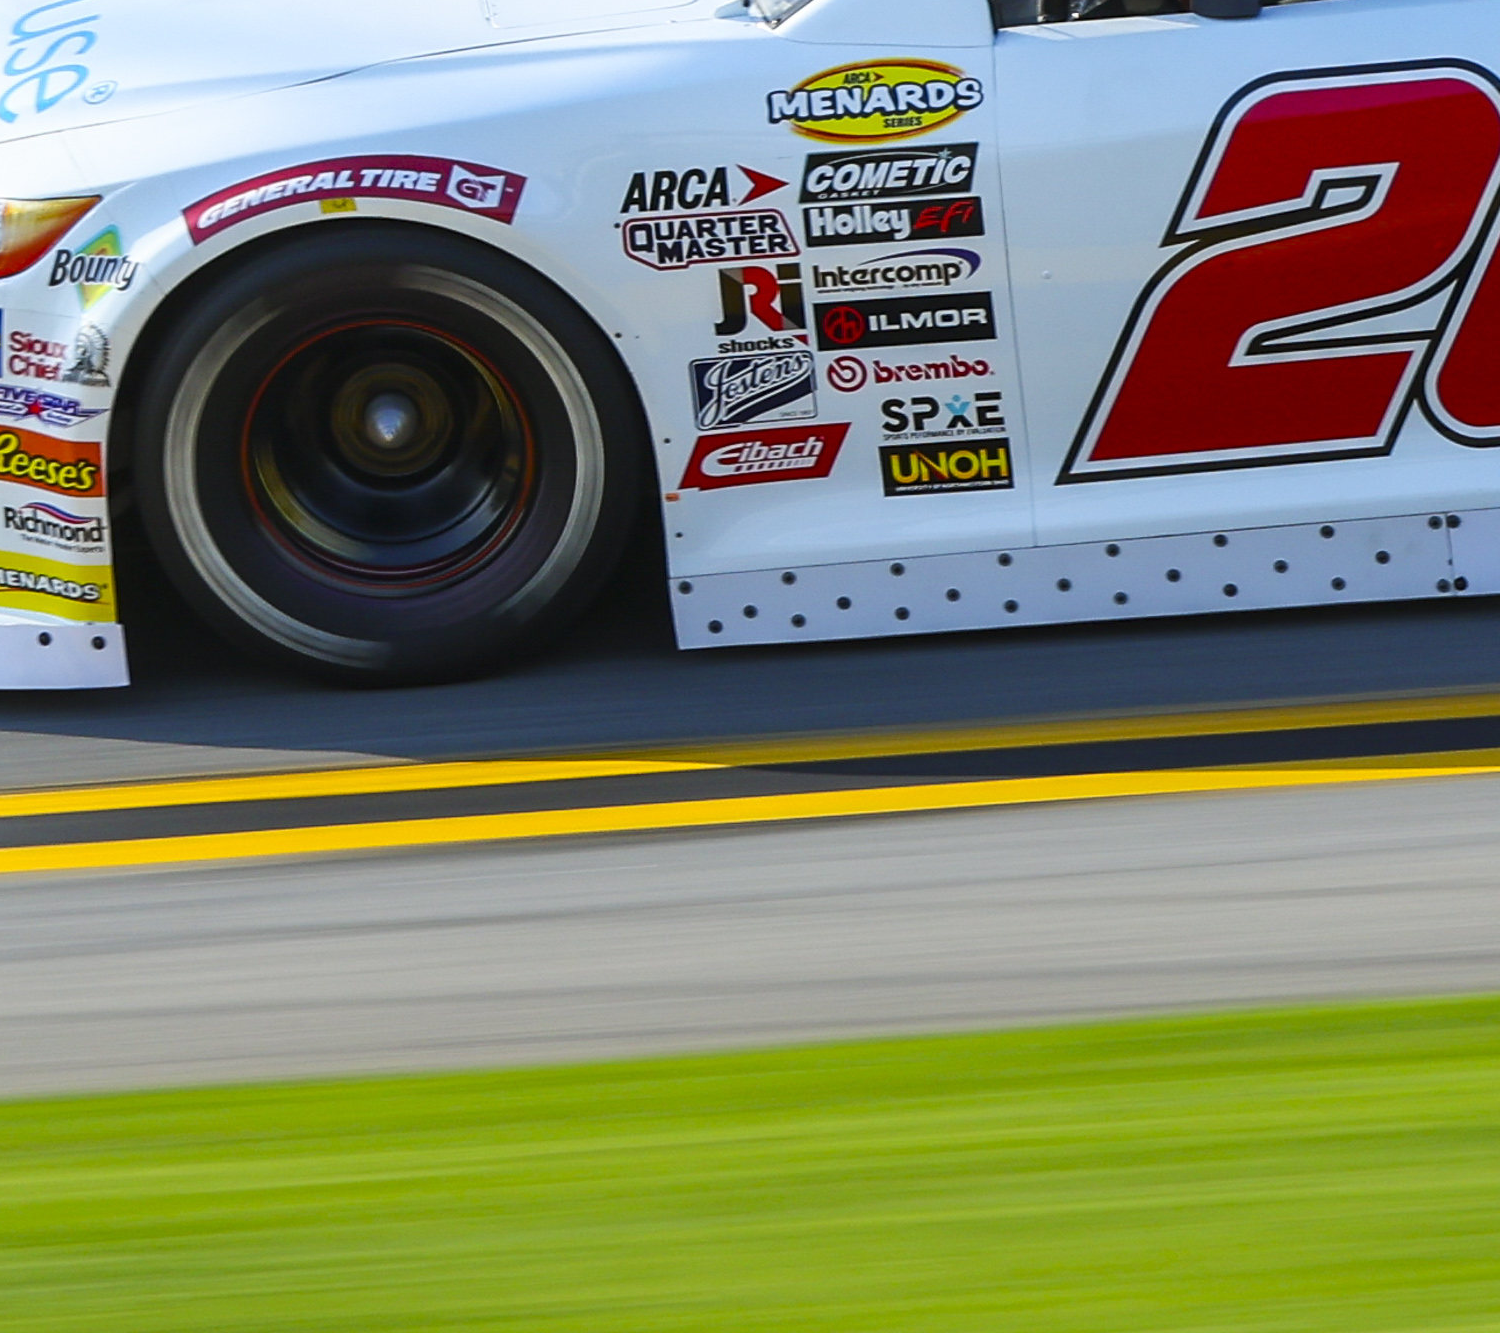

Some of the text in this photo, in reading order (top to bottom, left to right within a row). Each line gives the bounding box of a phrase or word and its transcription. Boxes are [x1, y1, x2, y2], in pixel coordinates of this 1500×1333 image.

[768, 78, 984, 124] MENARDS
[620, 166, 730, 214] ARCA
[806, 155, 972, 194] COMETIC
[196, 170, 355, 229] GENERAL
[359, 169, 442, 192] TIRE
[818, 190, 880, 200] GASKET
[628, 214, 781, 253] QUARTER
[808, 205, 912, 240] Holley
[656, 233, 791, 265] MASTER
[48, 249, 139, 292] Bounty
[812, 261, 962, 288] Intercomp
[868, 308, 988, 332] ILMOR
[9, 331, 68, 359] Sioux
[718, 336, 795, 354] shocks
[8, 355, 63, 380] Chief
[872, 355, 990, 384] brembo
[700, 353, 813, 429] Jostens
[700, 436, 824, 477] Eibach
[890, 448, 1009, 484] UNOH
[3, 506, 105, 544] Richmond
